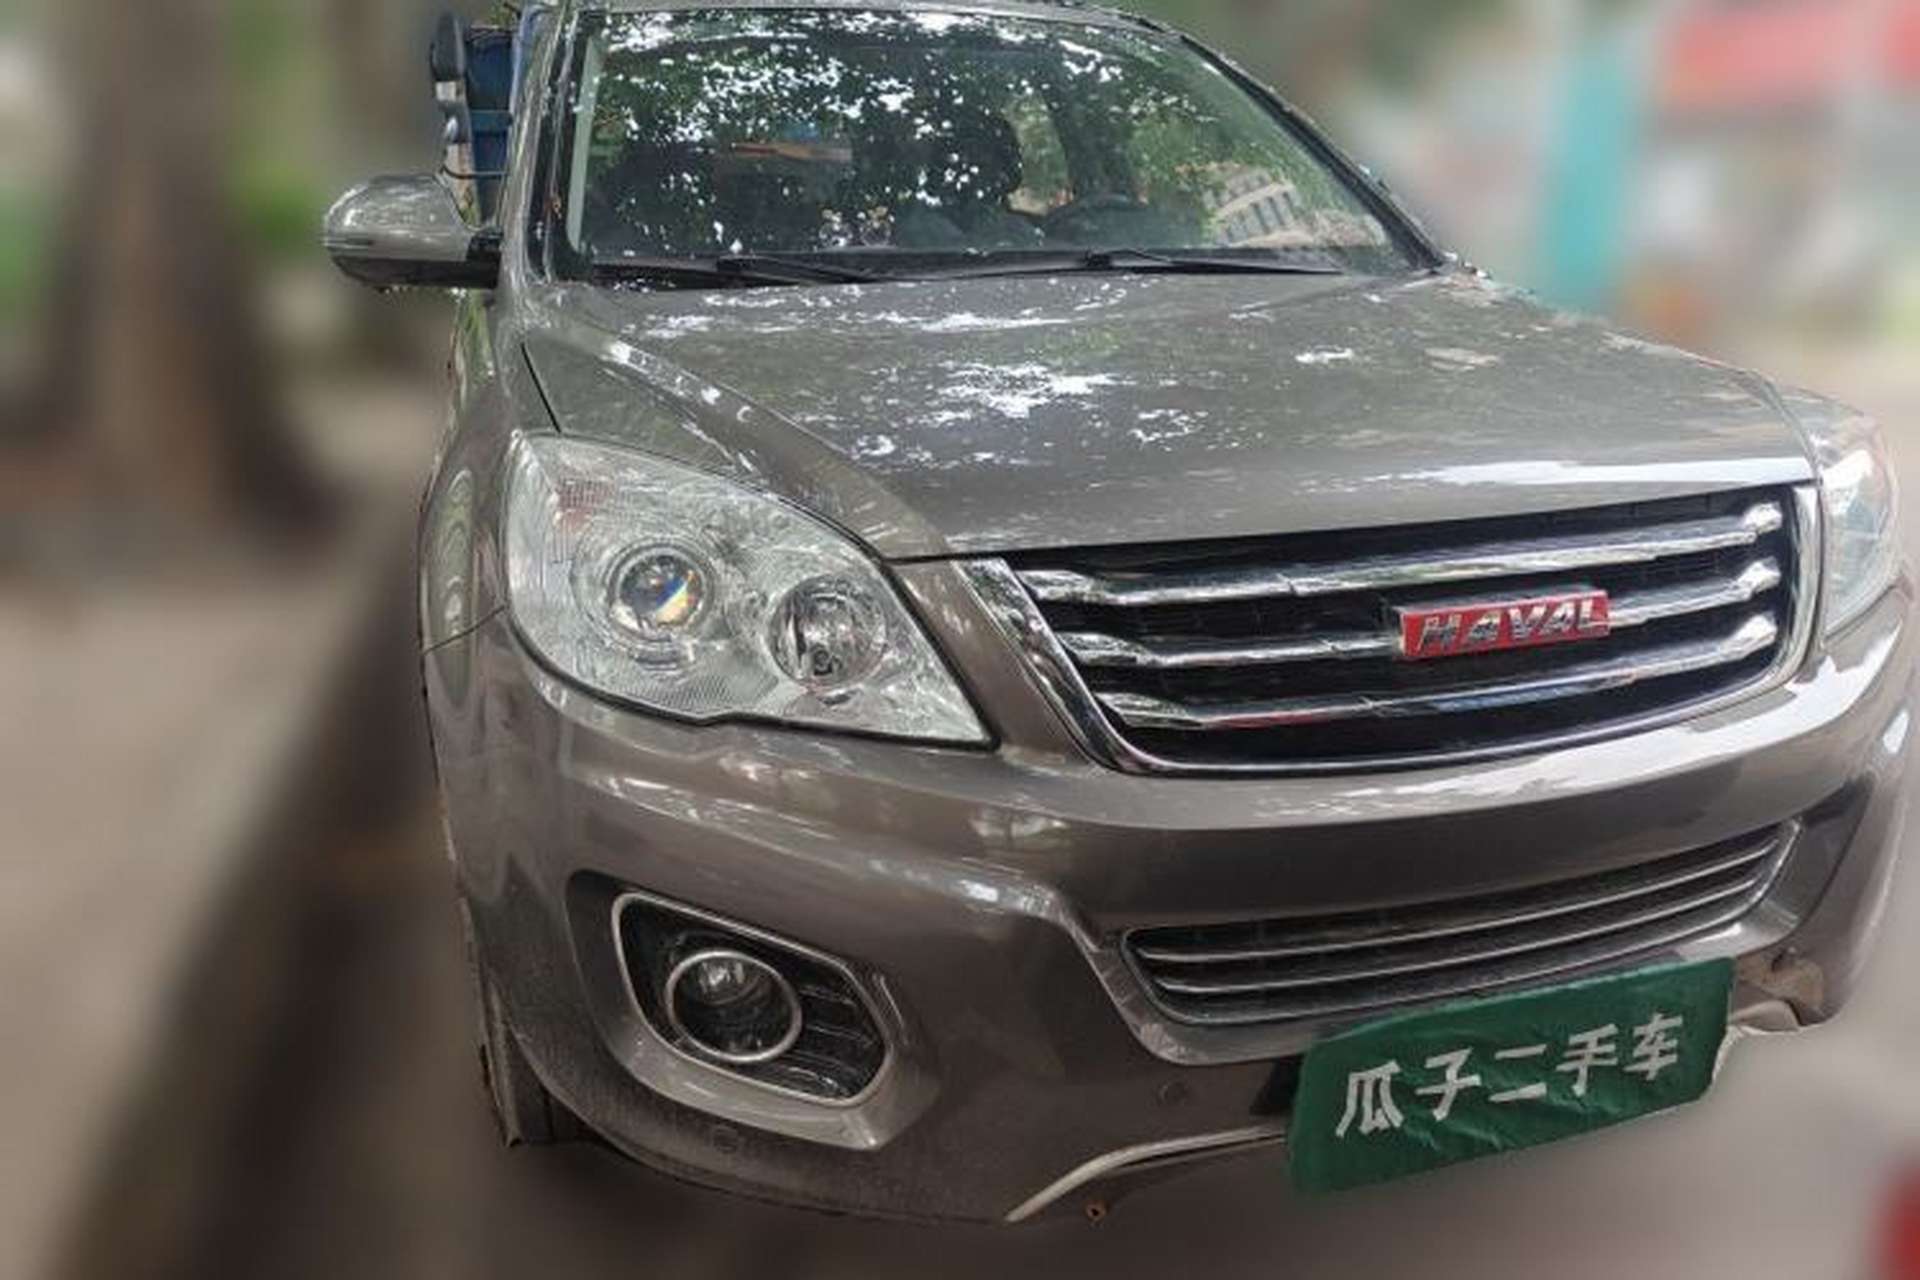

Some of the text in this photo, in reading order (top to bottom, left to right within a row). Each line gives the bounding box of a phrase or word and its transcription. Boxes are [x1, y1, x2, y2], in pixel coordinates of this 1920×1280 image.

[1417, 600, 1602, 651] HAVAL
[1335, 1012, 1683, 1138] 瓜子二手车
